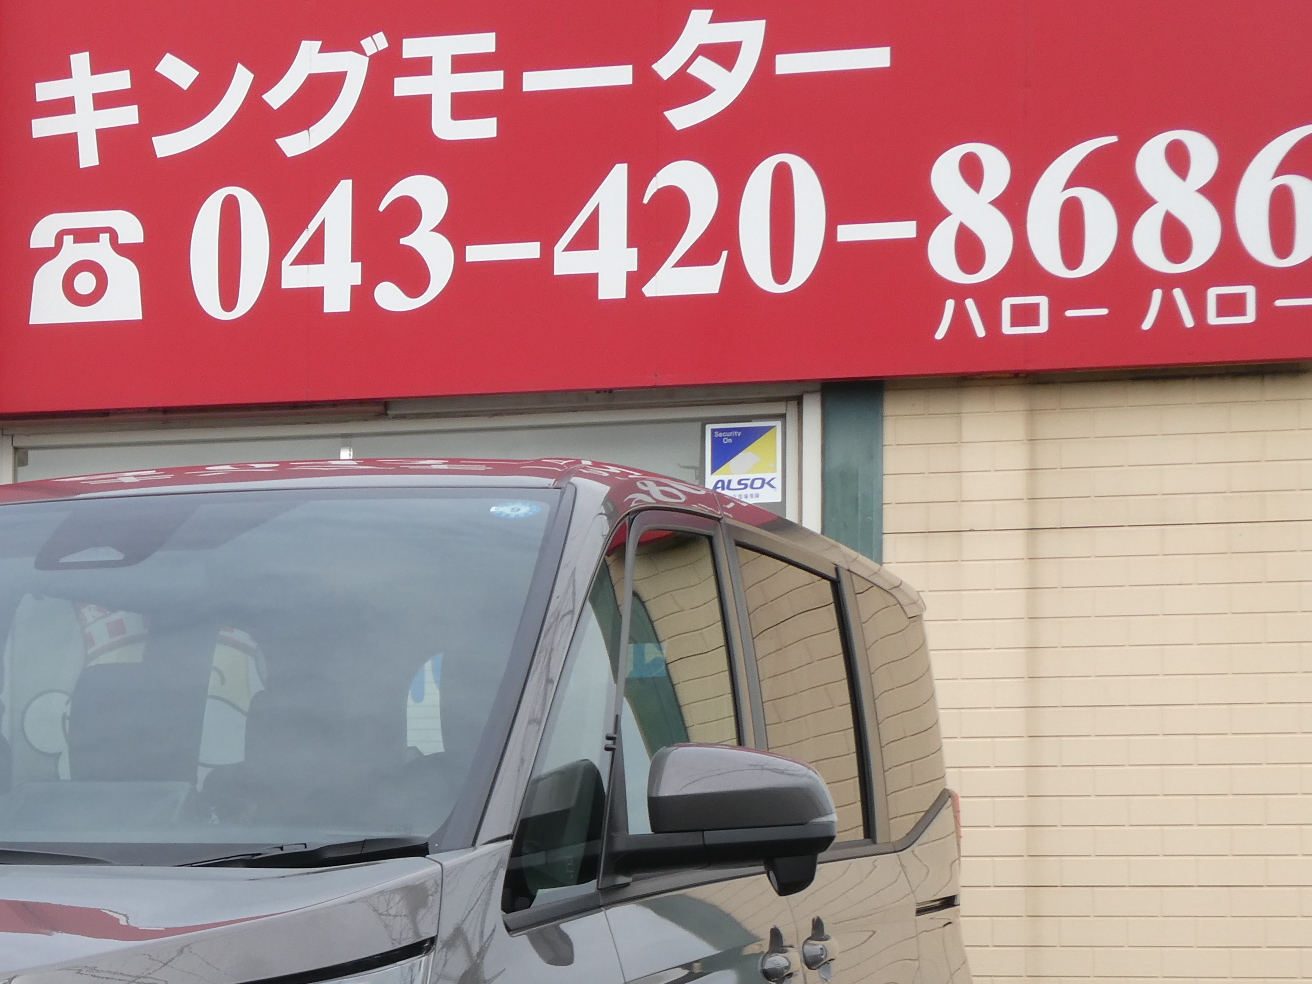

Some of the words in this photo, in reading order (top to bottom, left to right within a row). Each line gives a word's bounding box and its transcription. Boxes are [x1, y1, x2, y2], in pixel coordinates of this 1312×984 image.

[31, 9, 891, 168] キングモーター
[934, 295, 1109, 340] ハロー
[712, 477, 776, 491] ALSOK
